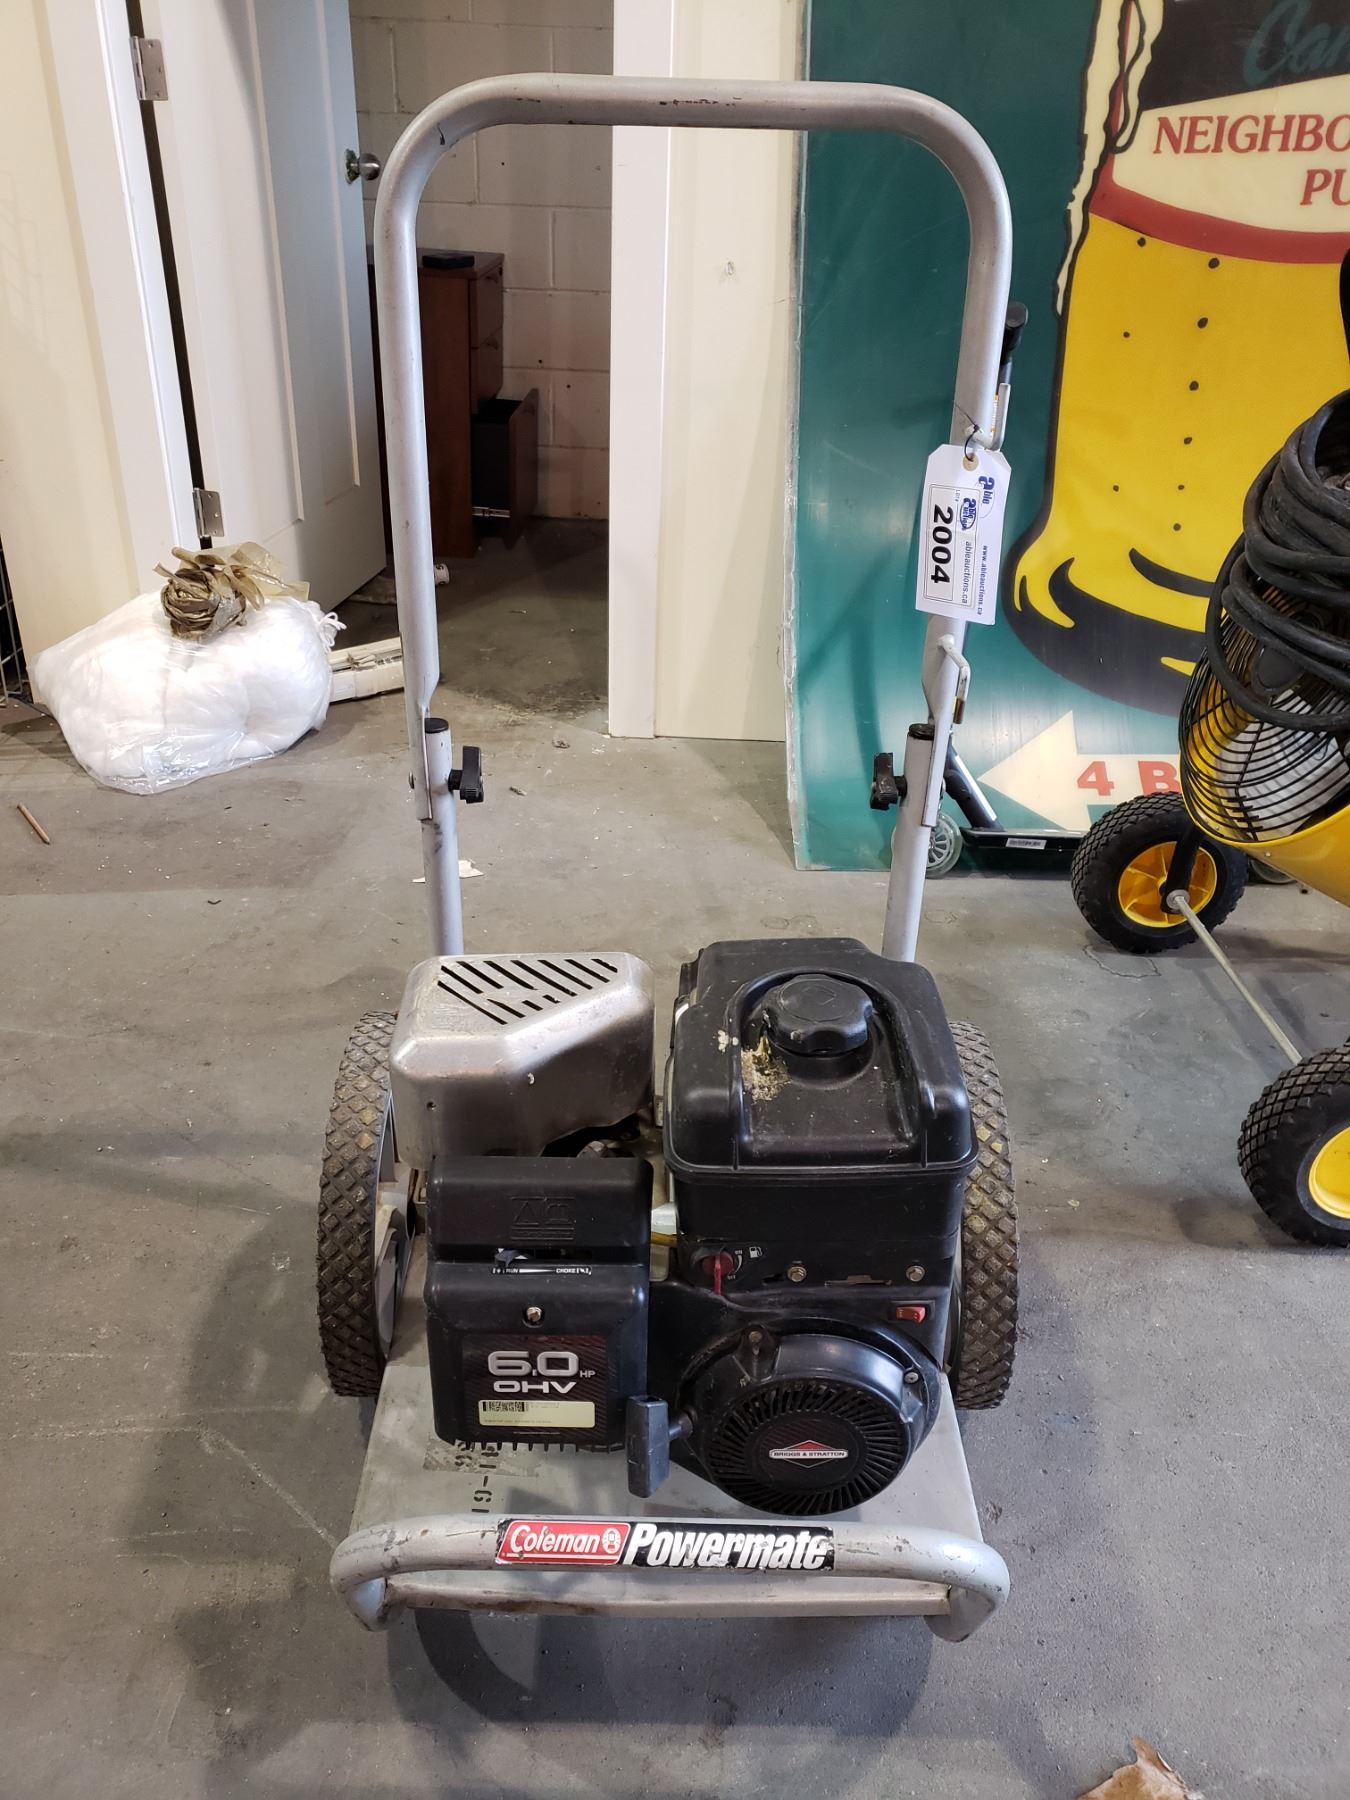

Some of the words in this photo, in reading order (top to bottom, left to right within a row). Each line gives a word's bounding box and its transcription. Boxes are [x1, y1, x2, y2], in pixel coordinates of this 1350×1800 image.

[1153, 114, 1350, 155] NEIGHBO
[930, 503, 954, 584] 2004
[961, 541, 972, 604] ableauctions.ca
[976, 545, 988, 616] www.ableauctions.ca
[1077, 760, 1115, 796] 4
[555, 1267, 577, 1275] CHOKE
[487, 1350, 579, 1377] 6.0
[579, 1370, 596, 1378] HP
[493, 1380, 577, 1394] OHV
[509, 1524, 601, 1554] Coleman
[621, 1523, 832, 1569] Powermate
